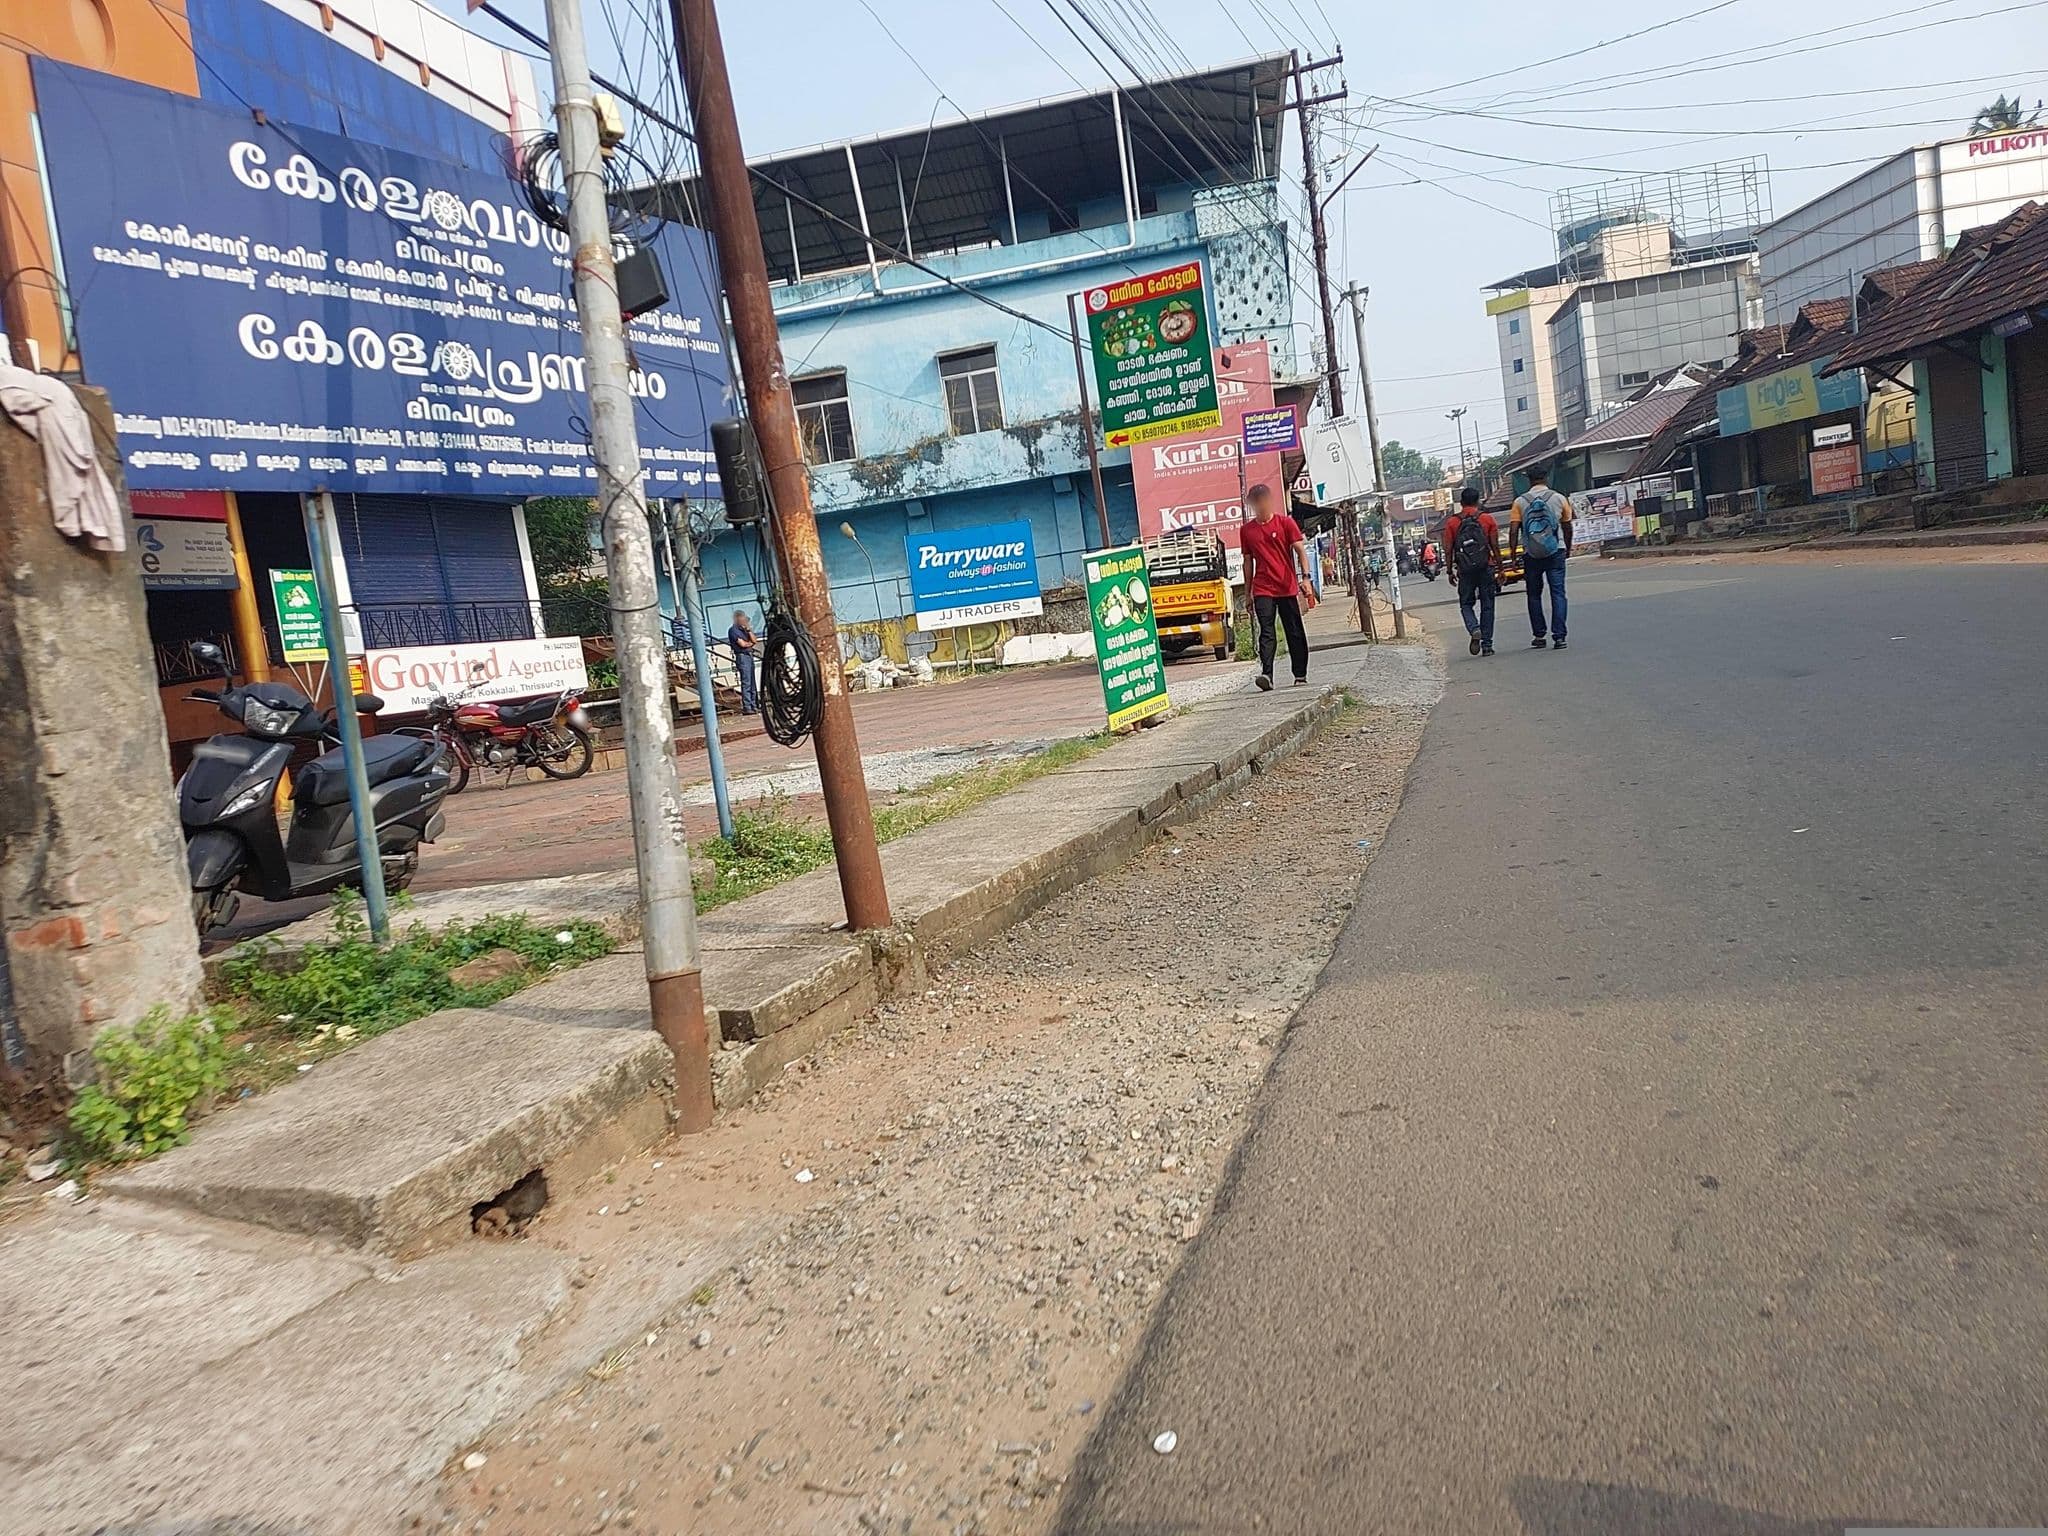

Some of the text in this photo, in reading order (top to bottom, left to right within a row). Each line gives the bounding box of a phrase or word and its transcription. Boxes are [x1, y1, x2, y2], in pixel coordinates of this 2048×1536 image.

[1969, 131, 2048, 157] PULIKOTT
[229, 141, 422, 223] കേരള
[396, 236, 505, 276] ദിനപത്രം
[1109, 267, 1198, 303] വനിത ഹോട്ടൽ
[238, 313, 429, 377] കേരള
[1117, 348, 1188, 372] നാടൻ ഭക്ഷണം
[1109, 358, 1202, 391] വാഴയിലയിൽ ഊണ്
[406, 396, 515, 428] ദിനപത്രം
[918, 541, 1026, 570] Parryware
[948, 567, 980, 579] always
[991, 560, 1026, 575] fashion
[956, 601, 1021, 618] TRADERS
[1162, 592, 1216, 605] LEYLAND
[370, 647, 584, 692] Govind Agencies
[477, 686, 518, 698] Kokkalai,
